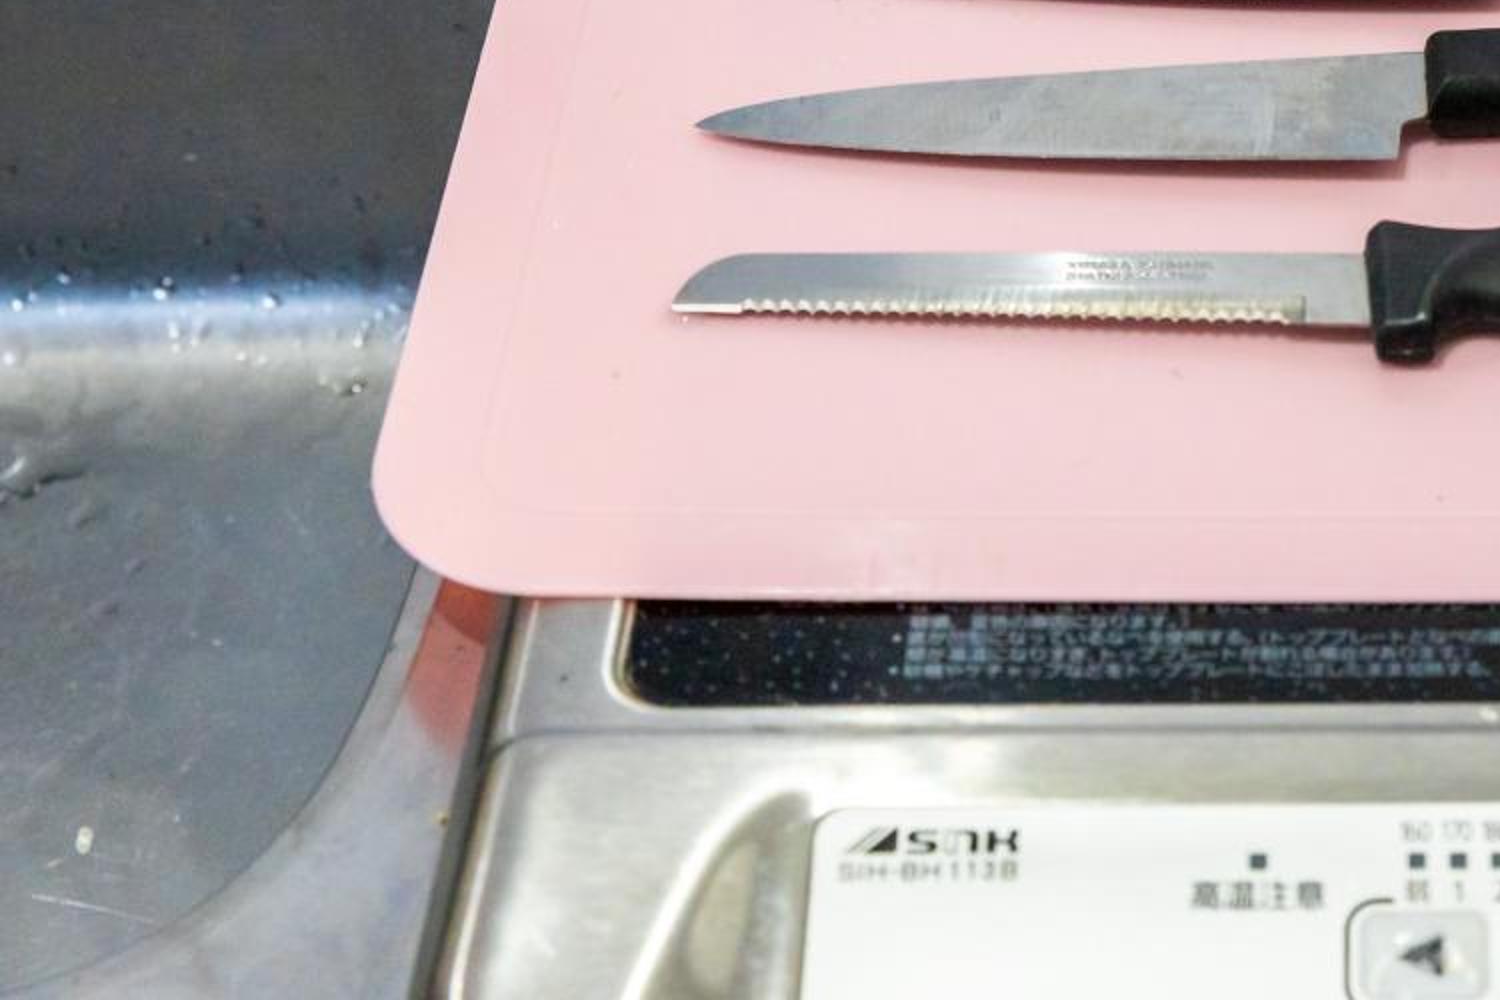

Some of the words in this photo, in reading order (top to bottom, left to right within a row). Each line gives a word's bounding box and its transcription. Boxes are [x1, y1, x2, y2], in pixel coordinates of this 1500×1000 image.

[1400, 820, 1434, 843] 160
[1442, 820, 1473, 843] 170
[1190, 881, 1324, 908] 高温注意
